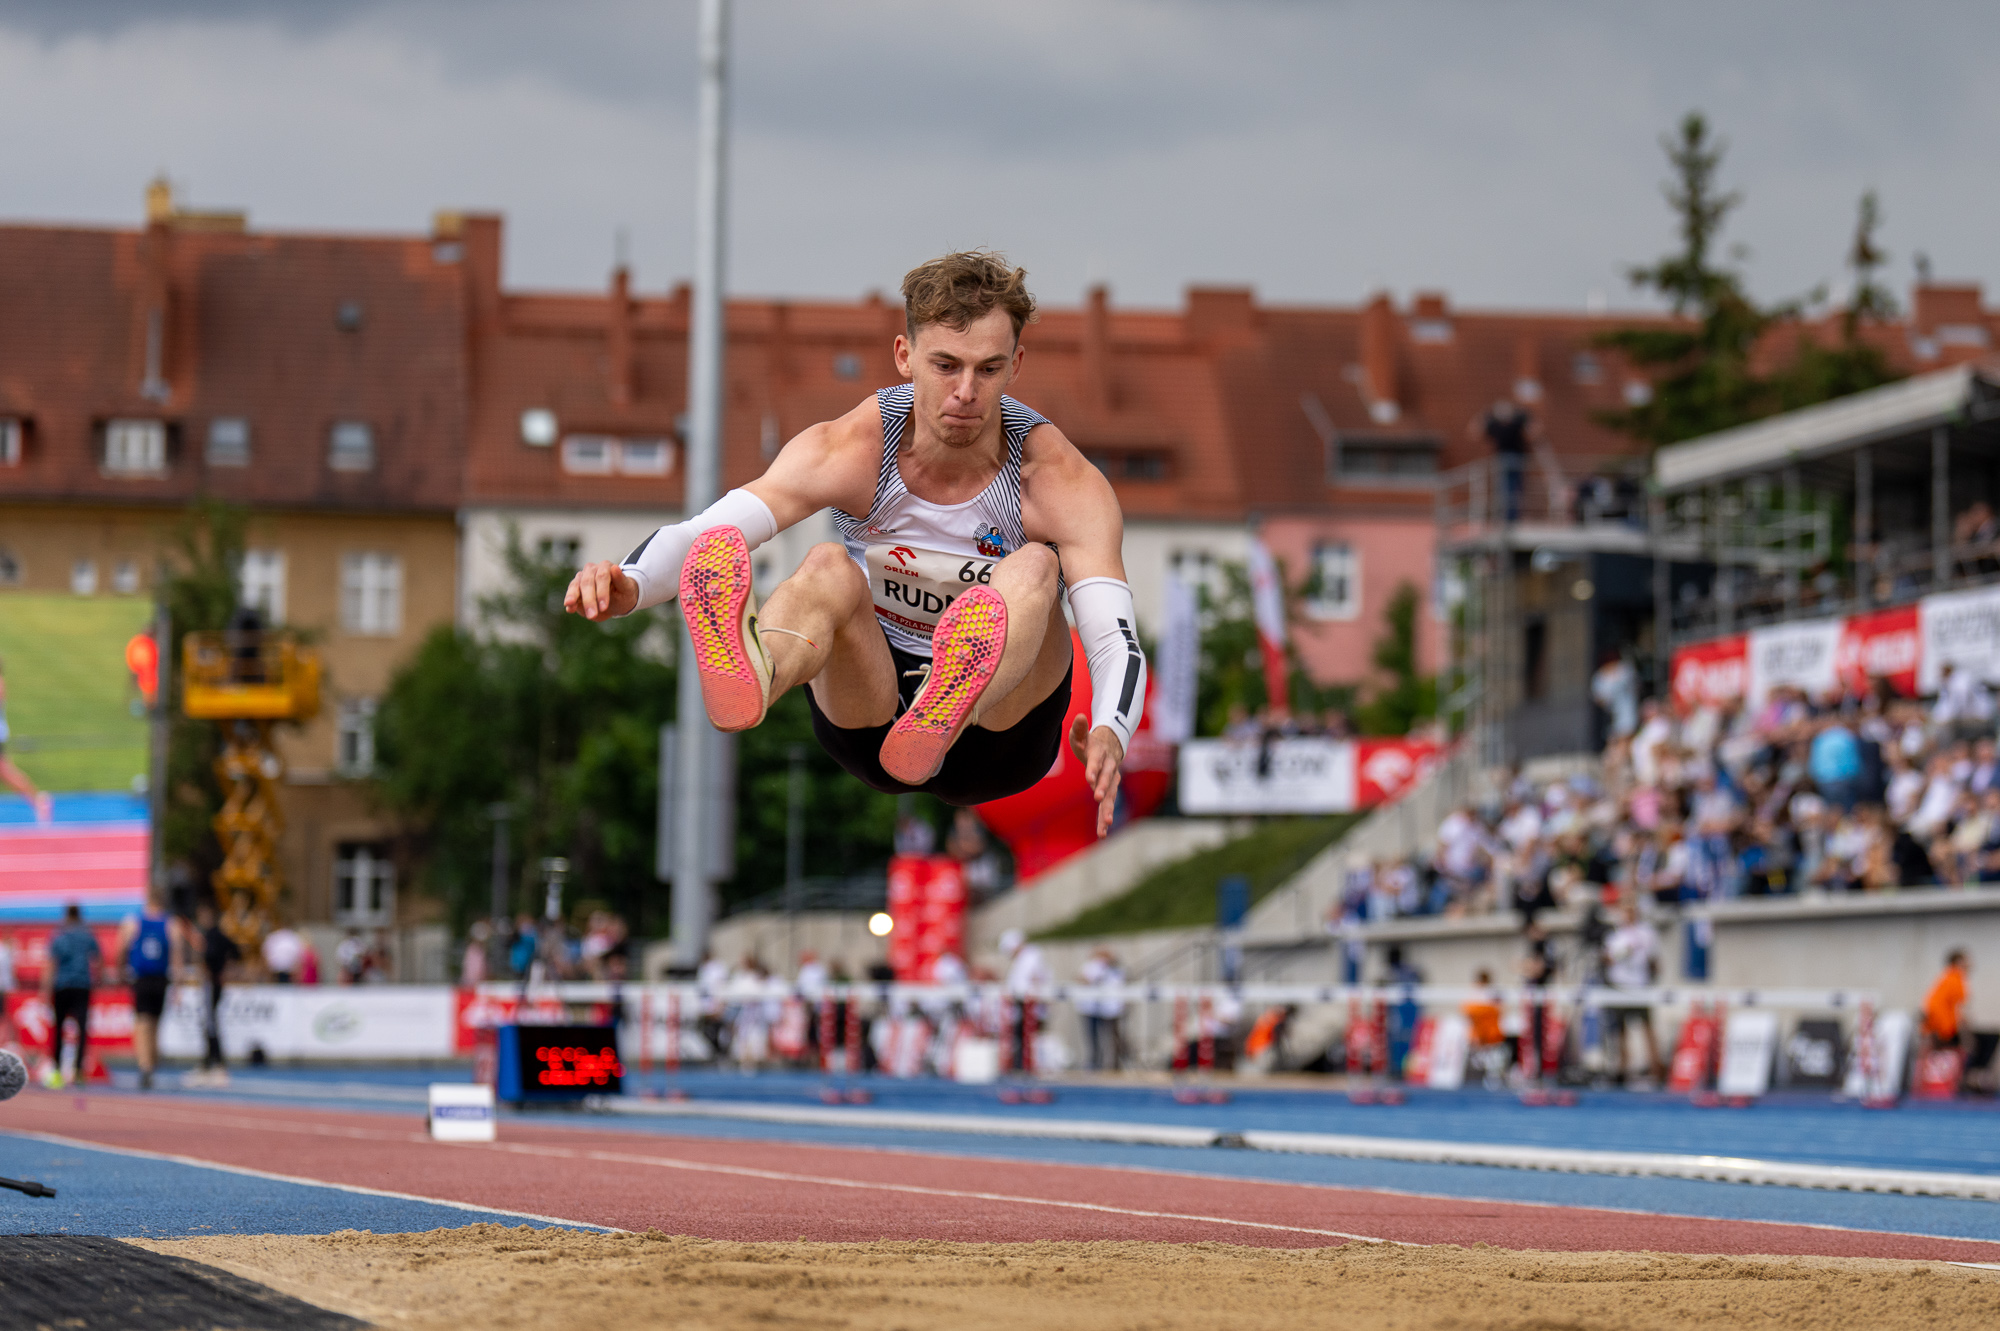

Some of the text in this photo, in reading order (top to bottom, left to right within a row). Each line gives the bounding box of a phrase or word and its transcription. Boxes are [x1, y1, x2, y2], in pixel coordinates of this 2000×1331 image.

[884, 565, 919, 578] ORLEN
[958, 560, 994, 584] 66
[899, 617, 918, 629] PZLA
